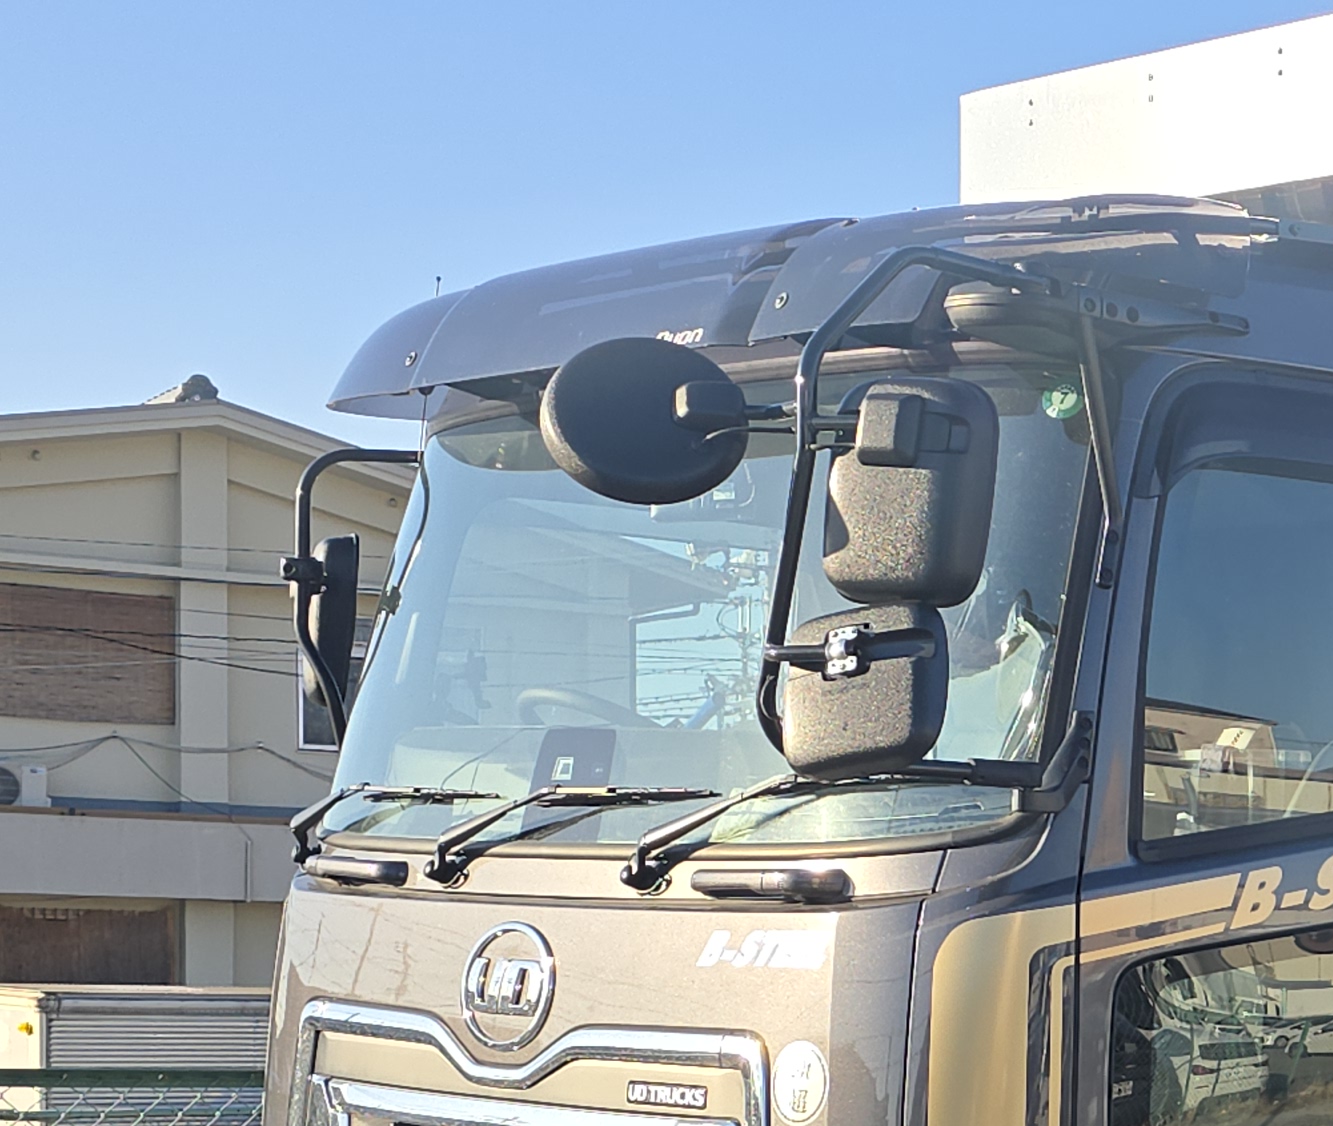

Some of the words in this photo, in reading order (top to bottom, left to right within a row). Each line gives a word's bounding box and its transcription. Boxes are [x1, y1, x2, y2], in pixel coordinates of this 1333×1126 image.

[695, 929, 829, 970] B-ST
[628, 1082, 647, 1102] UD
[649, 1085, 706, 1107] TRUCKS
